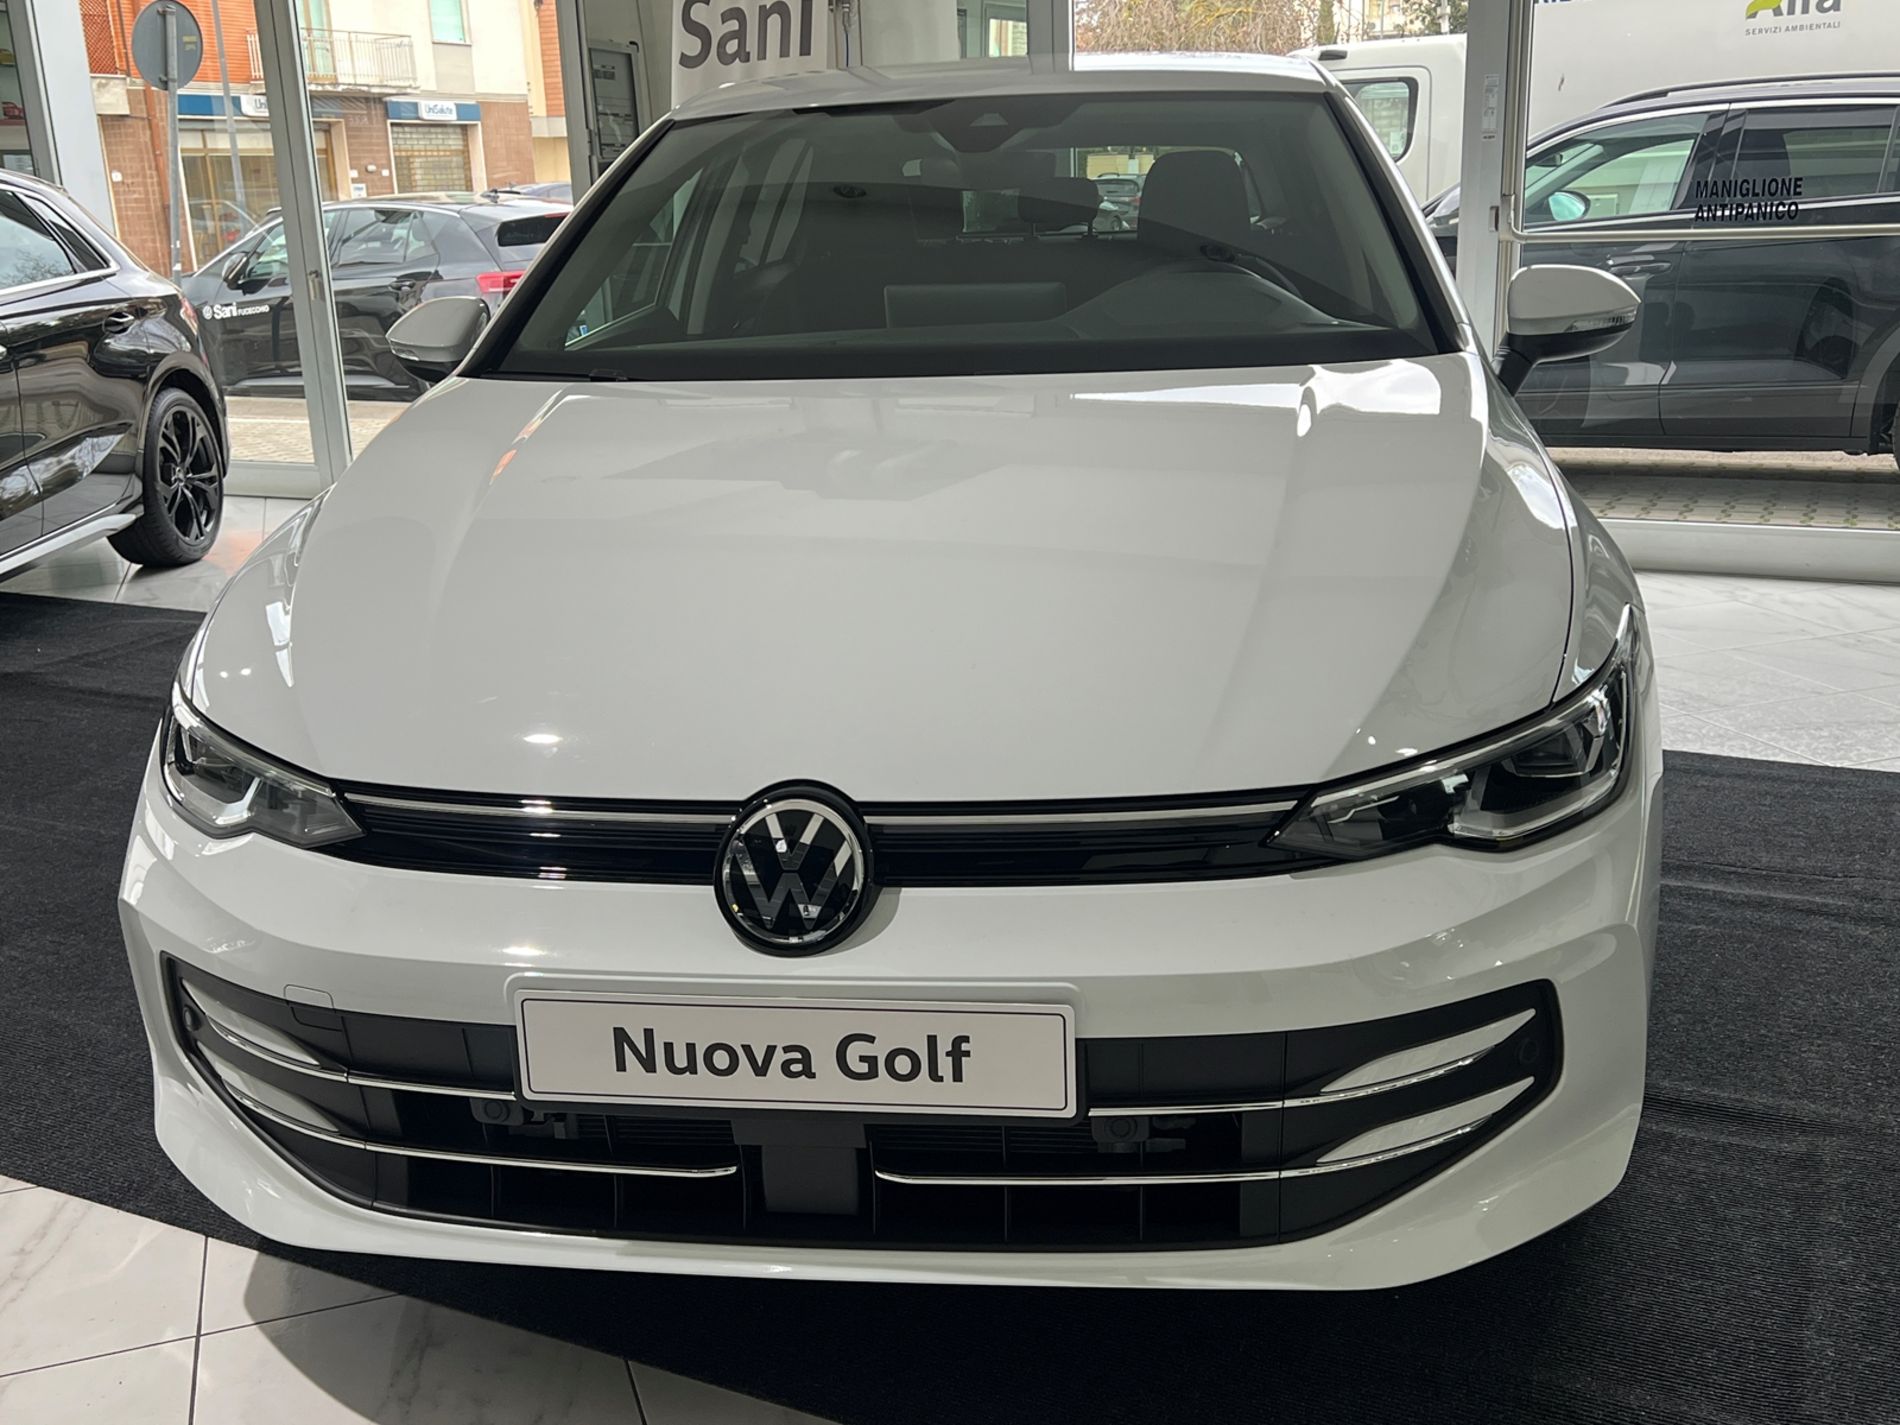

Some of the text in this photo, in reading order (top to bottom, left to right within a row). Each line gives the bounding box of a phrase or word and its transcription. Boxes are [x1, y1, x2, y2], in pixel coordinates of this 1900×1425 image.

[1745, 21, 1841, 36] SERVIZI AMBIENTALI
[1695, 177, 1803, 198] MANIGLIONE
[1695, 201, 1799, 222] ANTIPANICO
[213, 302, 237, 319] Sani
[612, 1026, 971, 1083] Nuova Golf
